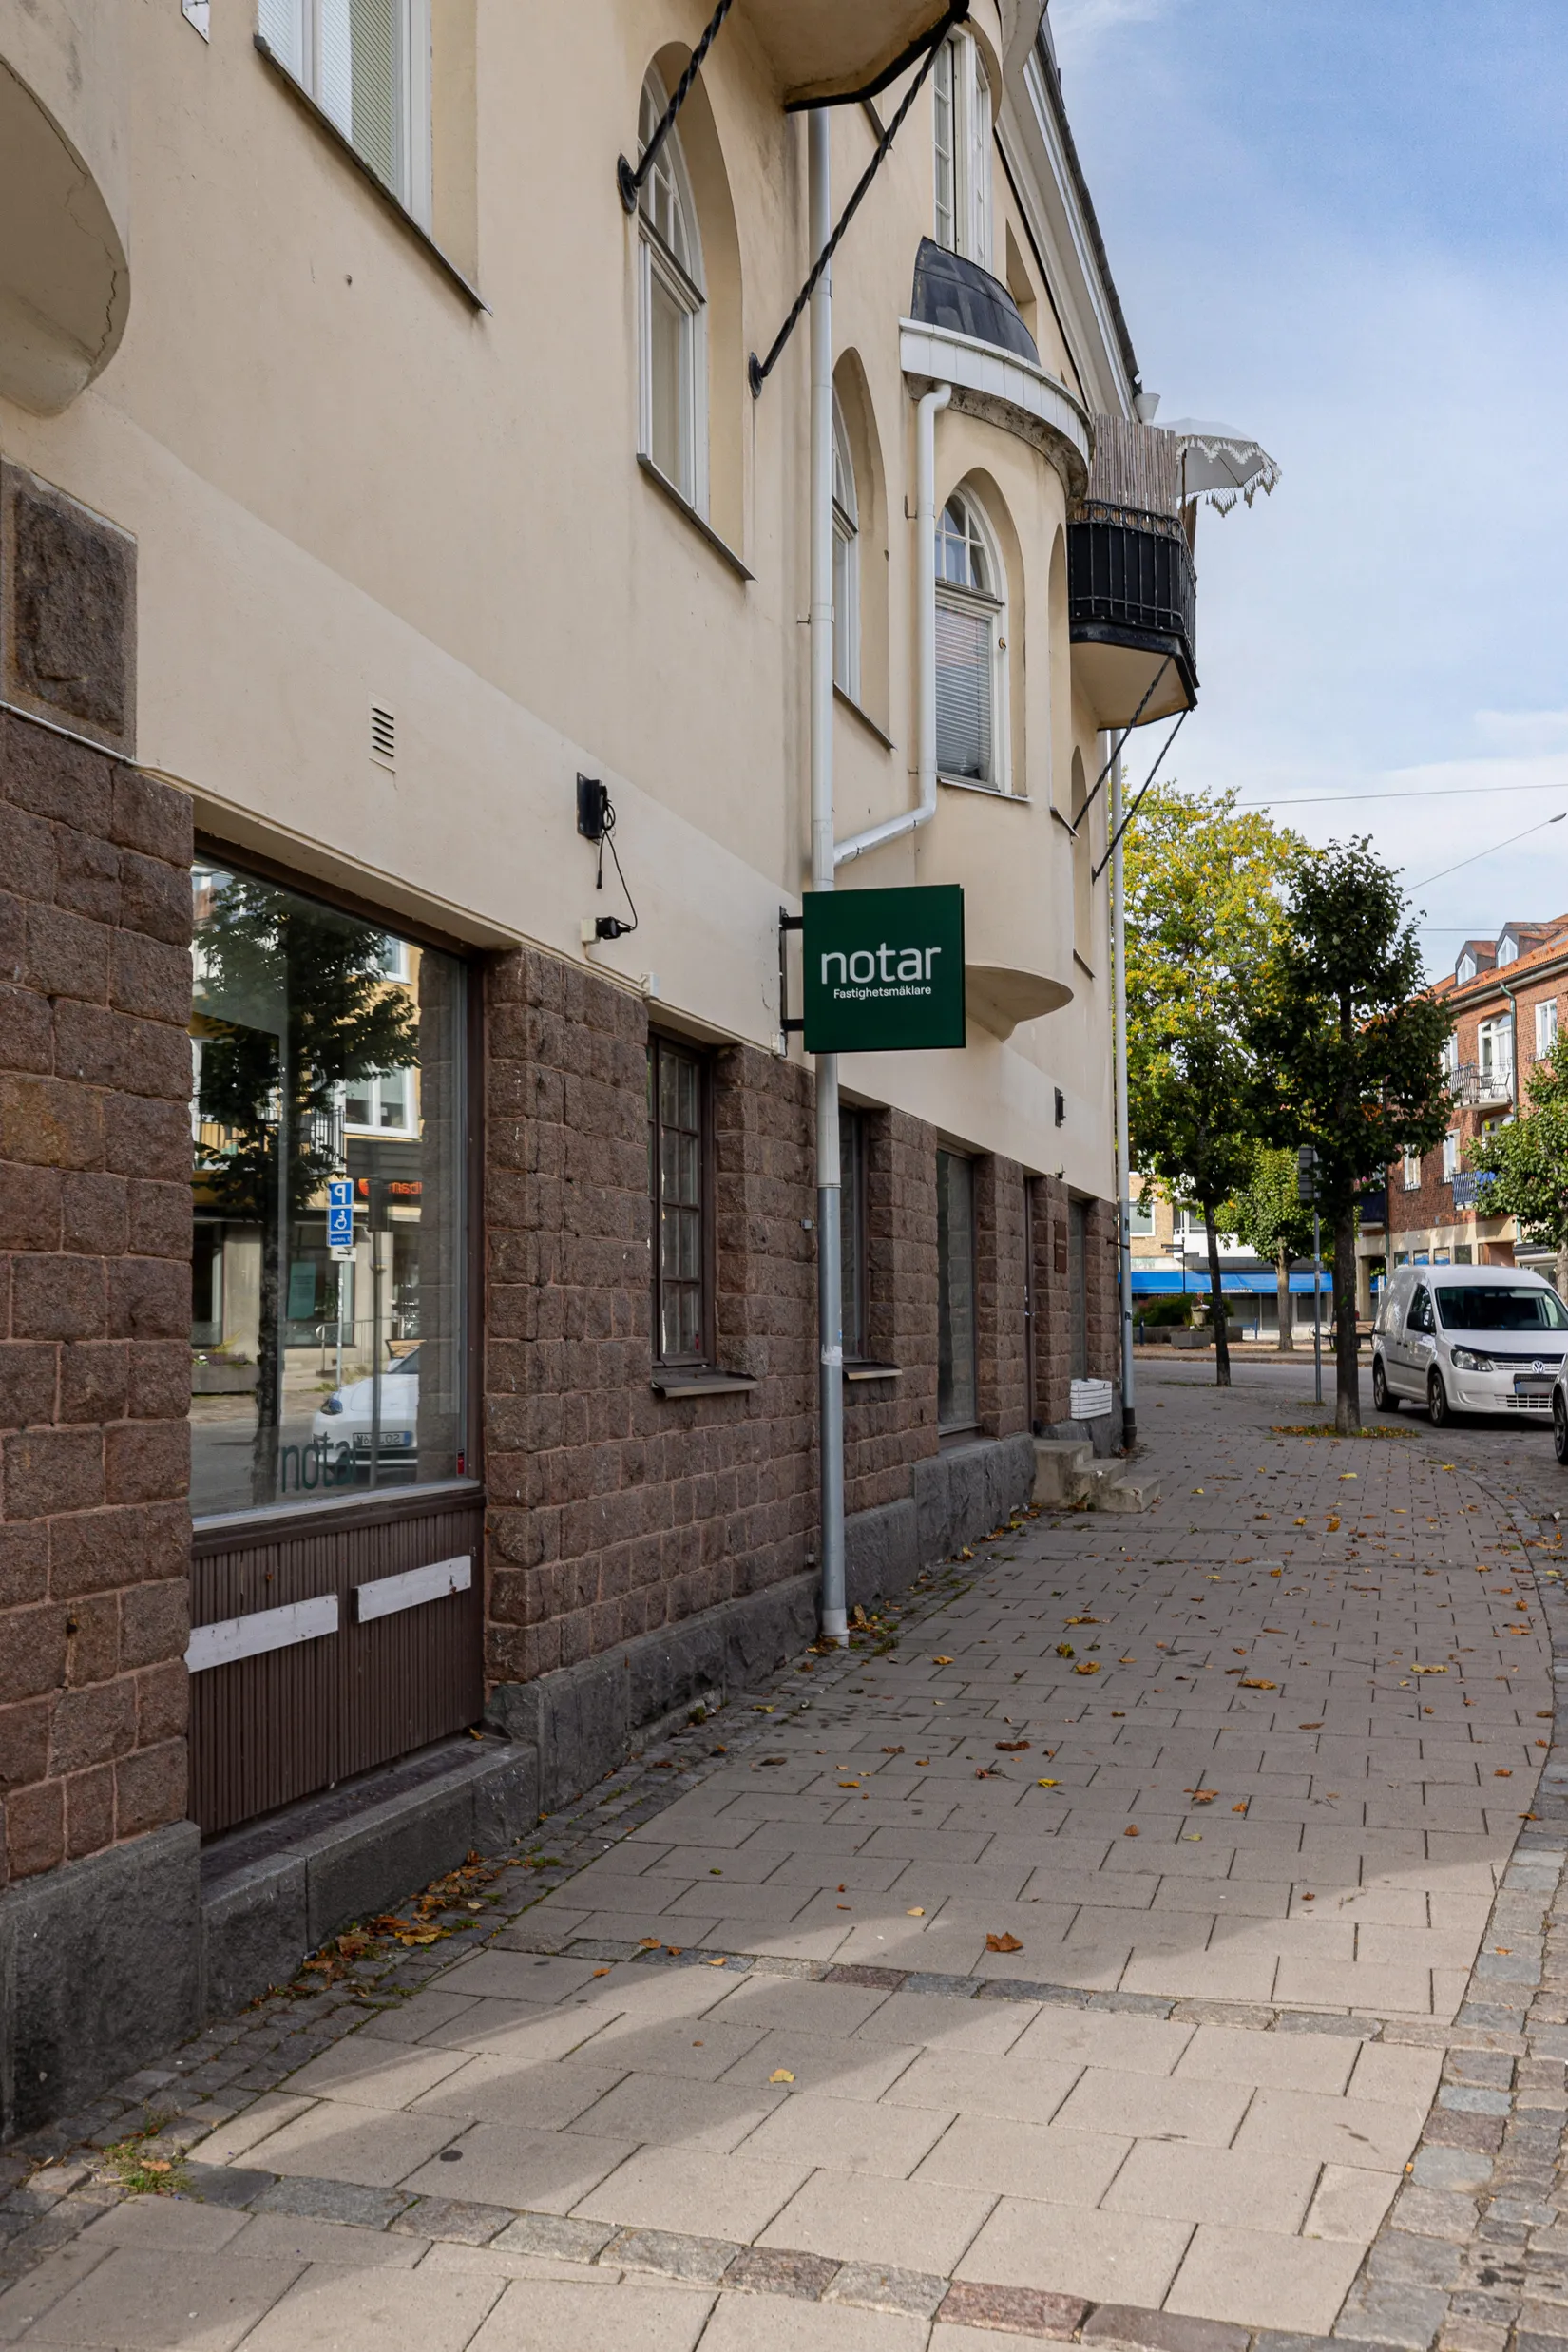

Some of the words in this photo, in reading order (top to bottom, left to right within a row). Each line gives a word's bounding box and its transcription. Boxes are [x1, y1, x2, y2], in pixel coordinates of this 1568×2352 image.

[821, 942, 942, 985] notar
[833, 985, 931, 1000] Fastighetsmäklare
[281, 1431, 361, 1493] notar
